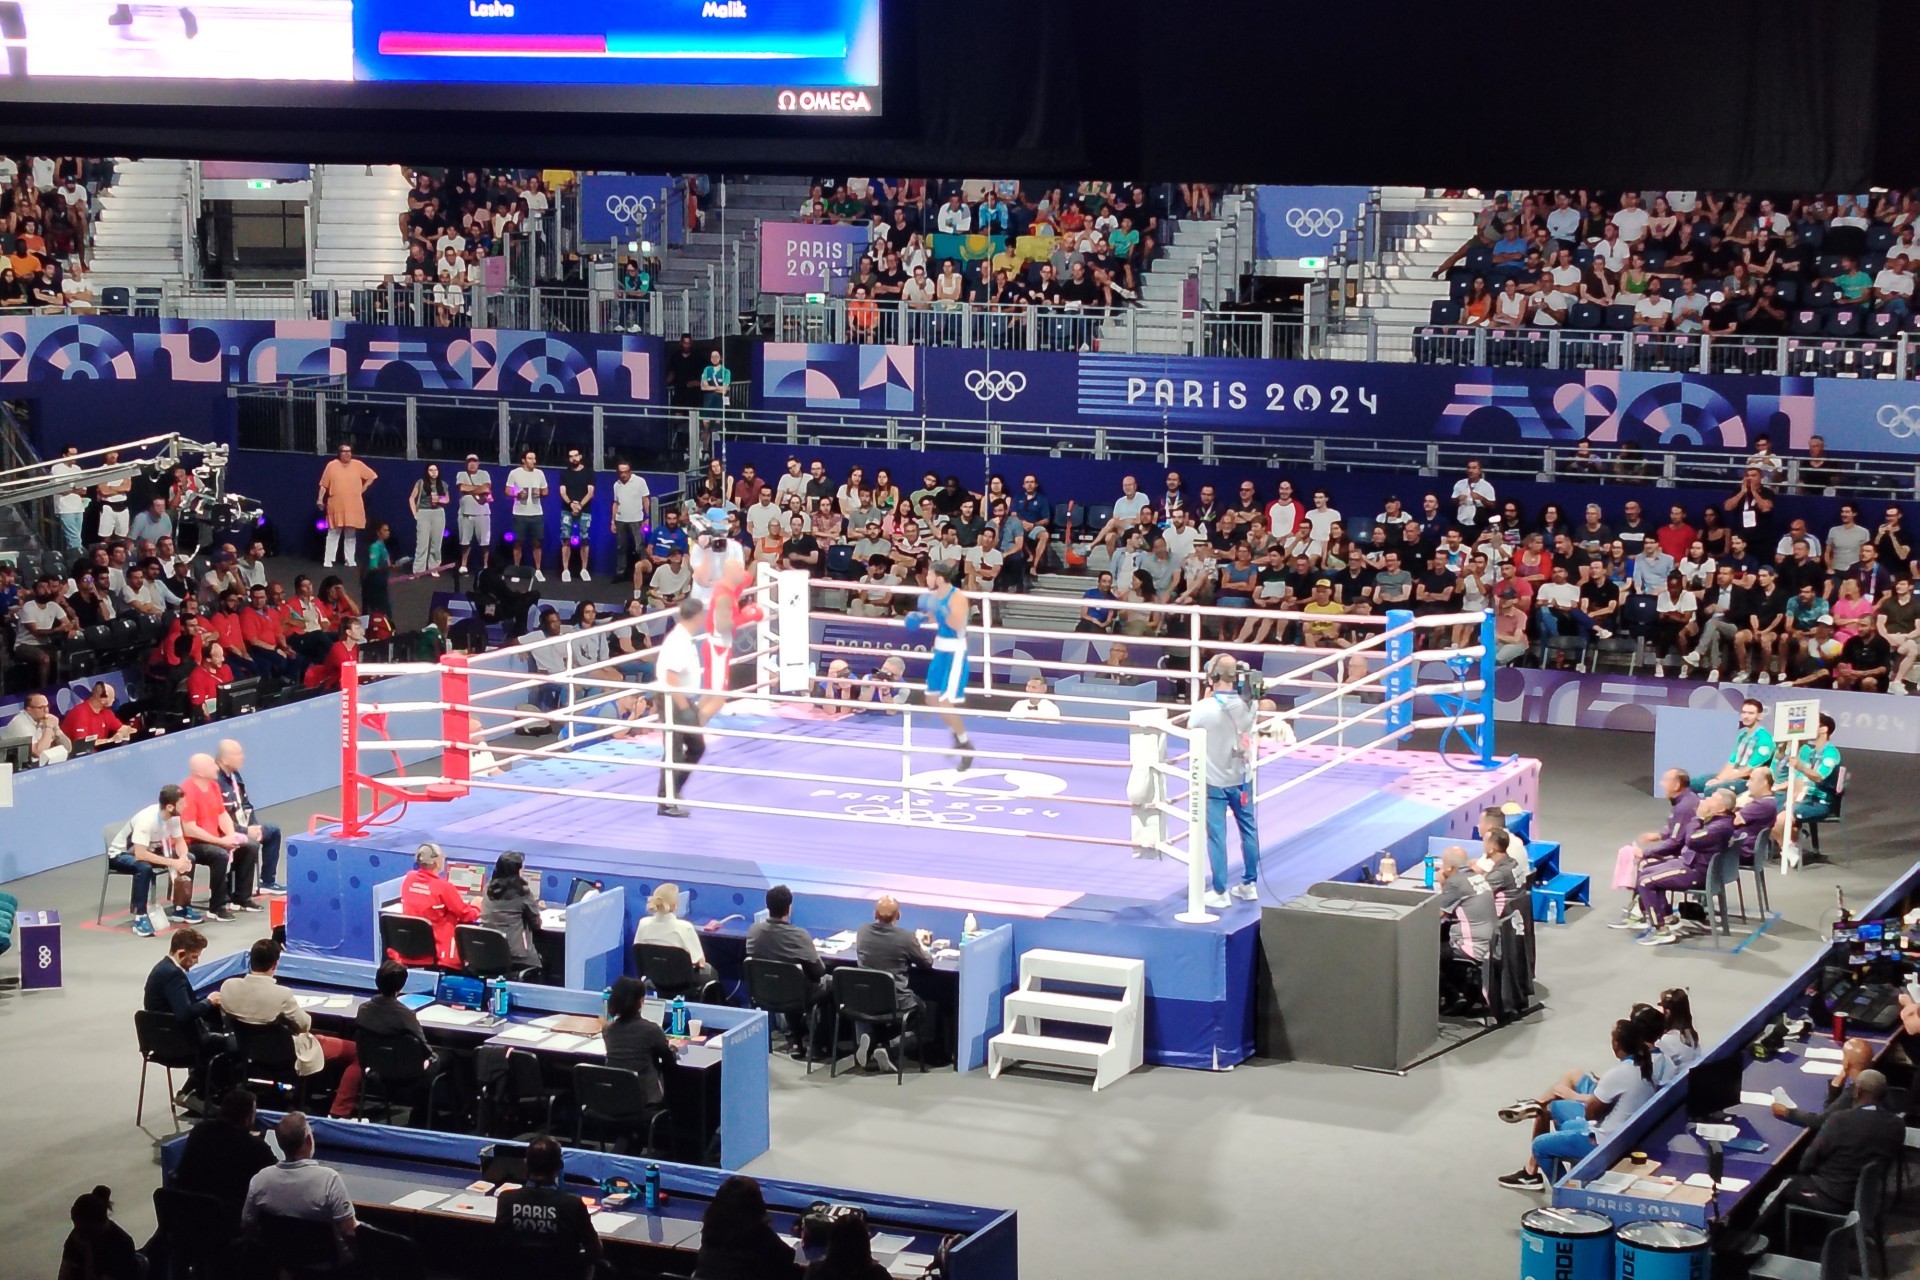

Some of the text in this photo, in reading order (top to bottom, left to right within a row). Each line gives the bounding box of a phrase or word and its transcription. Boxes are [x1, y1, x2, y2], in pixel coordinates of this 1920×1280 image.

[469, 0, 515, 18] Lasha
[701, 1, 748, 19] Malik
[799, 90, 872, 112] OMEGA
[1265, 382, 1378, 415] 2024
[1788, 706, 1807, 717] AZE
[1840, 711, 1905, 732] 2024
[1637, 1202, 1680, 1217] 2024
